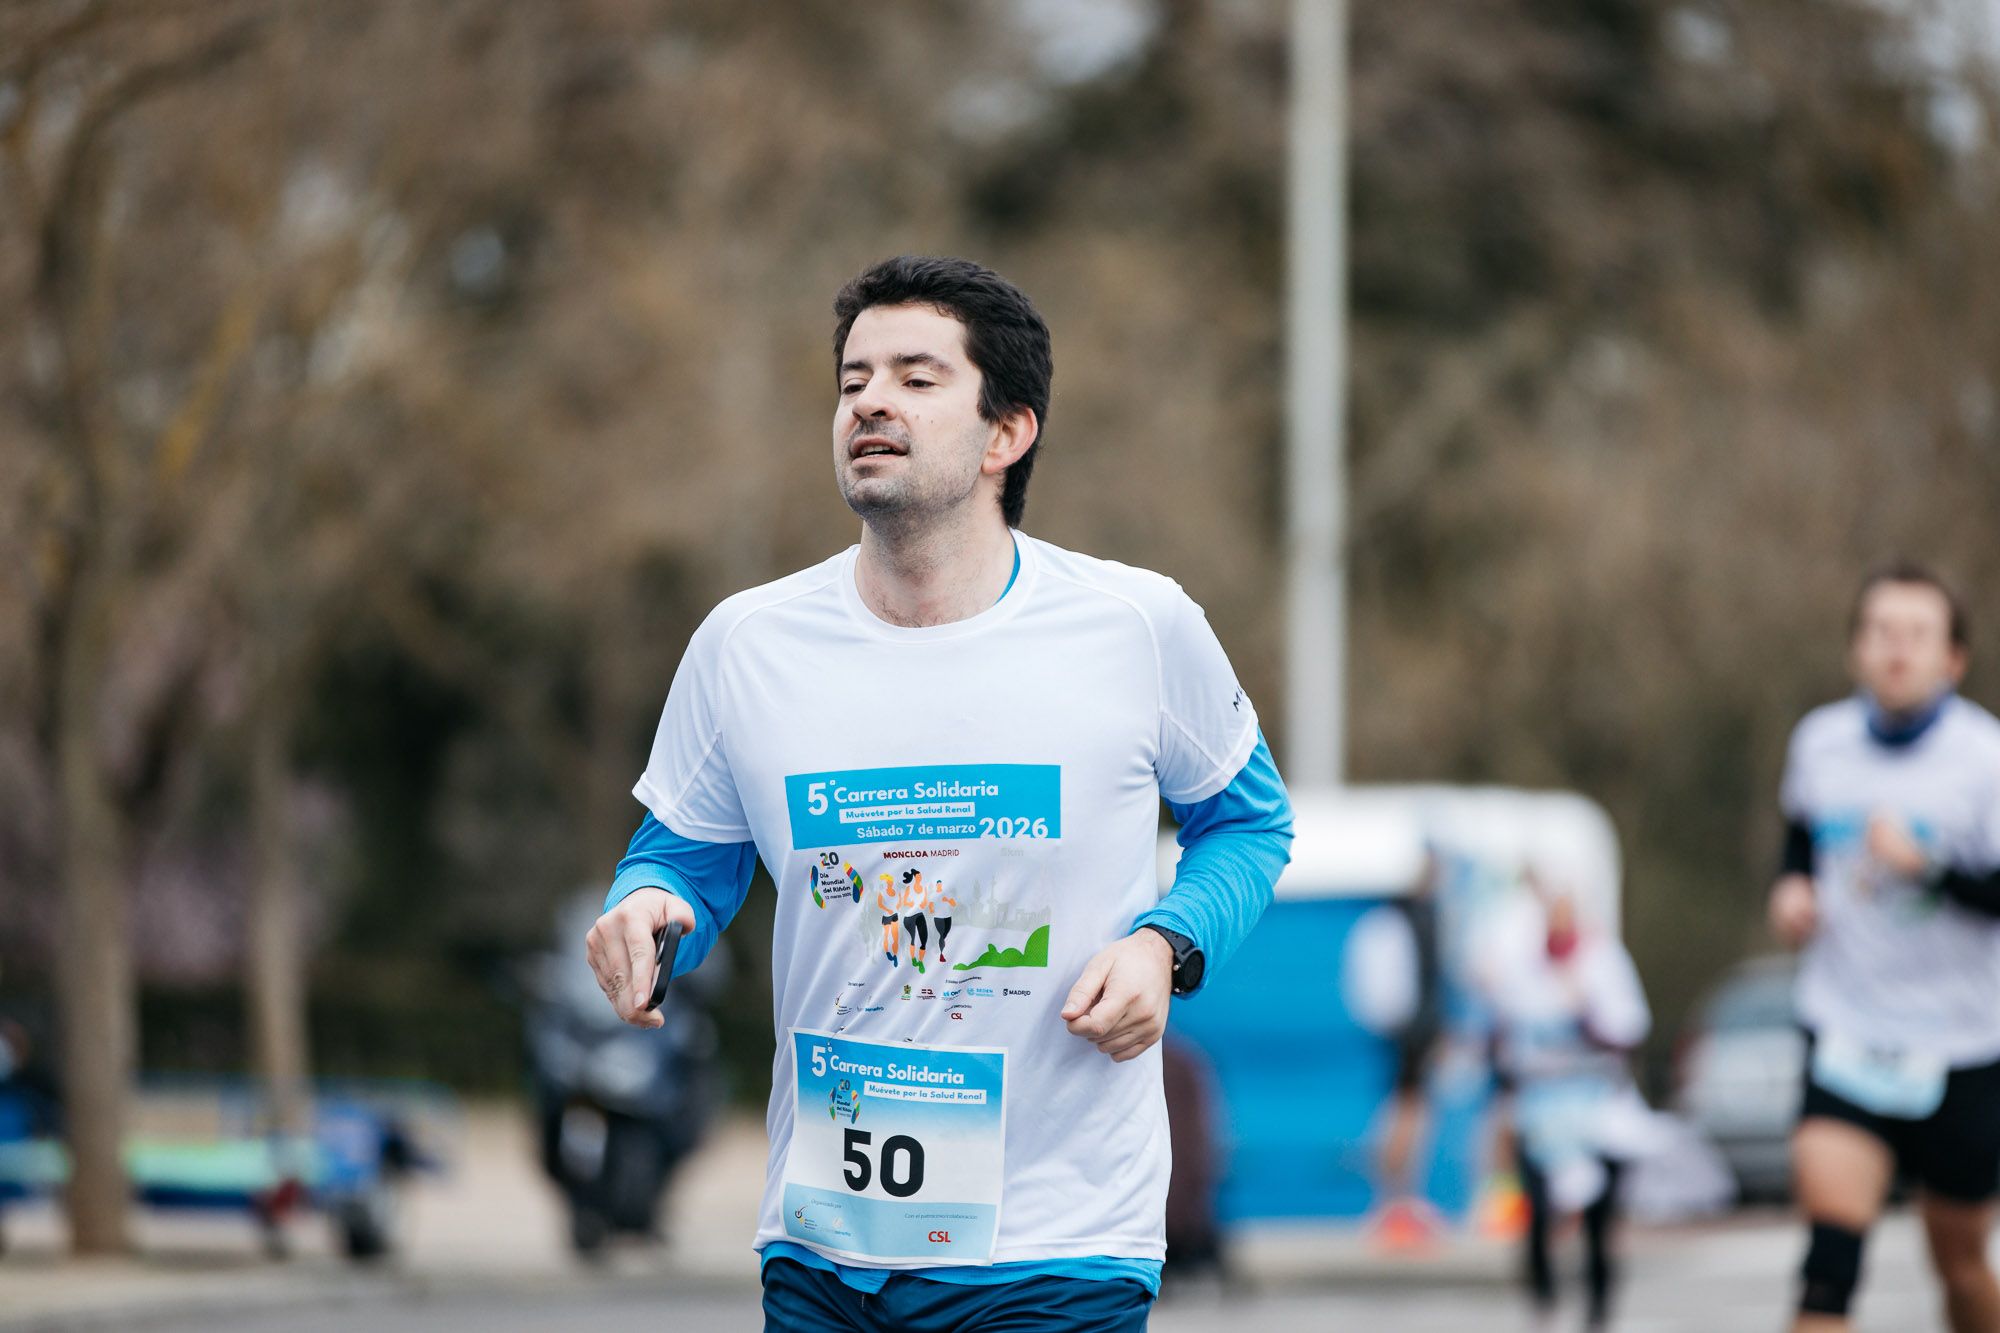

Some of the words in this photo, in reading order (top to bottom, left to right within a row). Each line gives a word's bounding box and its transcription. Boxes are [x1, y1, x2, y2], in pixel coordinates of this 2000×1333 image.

[834, 787, 908, 803] Carrera
[914, 780, 999, 798] Solidaria
[845, 809, 885, 819] Muévete
[888, 809, 902, 818] por
[905, 807, 914, 815] la
[917, 805, 943, 814] Salud
[945, 804, 971, 813] Renal
[856, 825, 903, 839] Sábado
[906, 824, 914, 835] 7
[918, 823, 934, 835] de
[936, 824, 976, 834] marzo
[979, 816, 1049, 838] 2026
[819, 851, 840, 867] 20
[883, 850, 929, 859] MONCLOA
[930, 848, 960, 857] MADRID
[950, 1012, 963, 1020] CSL
[830, 1055, 883, 1078] Carrera
[886, 1063, 965, 1085] Solidaria
[868, 1085, 901, 1096] Muévete
[902, 1090, 917, 1098] por
[919, 1089, 928, 1098] la
[930, 1090, 955, 1100] Salud
[957, 1091, 982, 1100] Renal
[843, 1127, 925, 1197] 50
[928, 1230, 951, 1243] CSL
